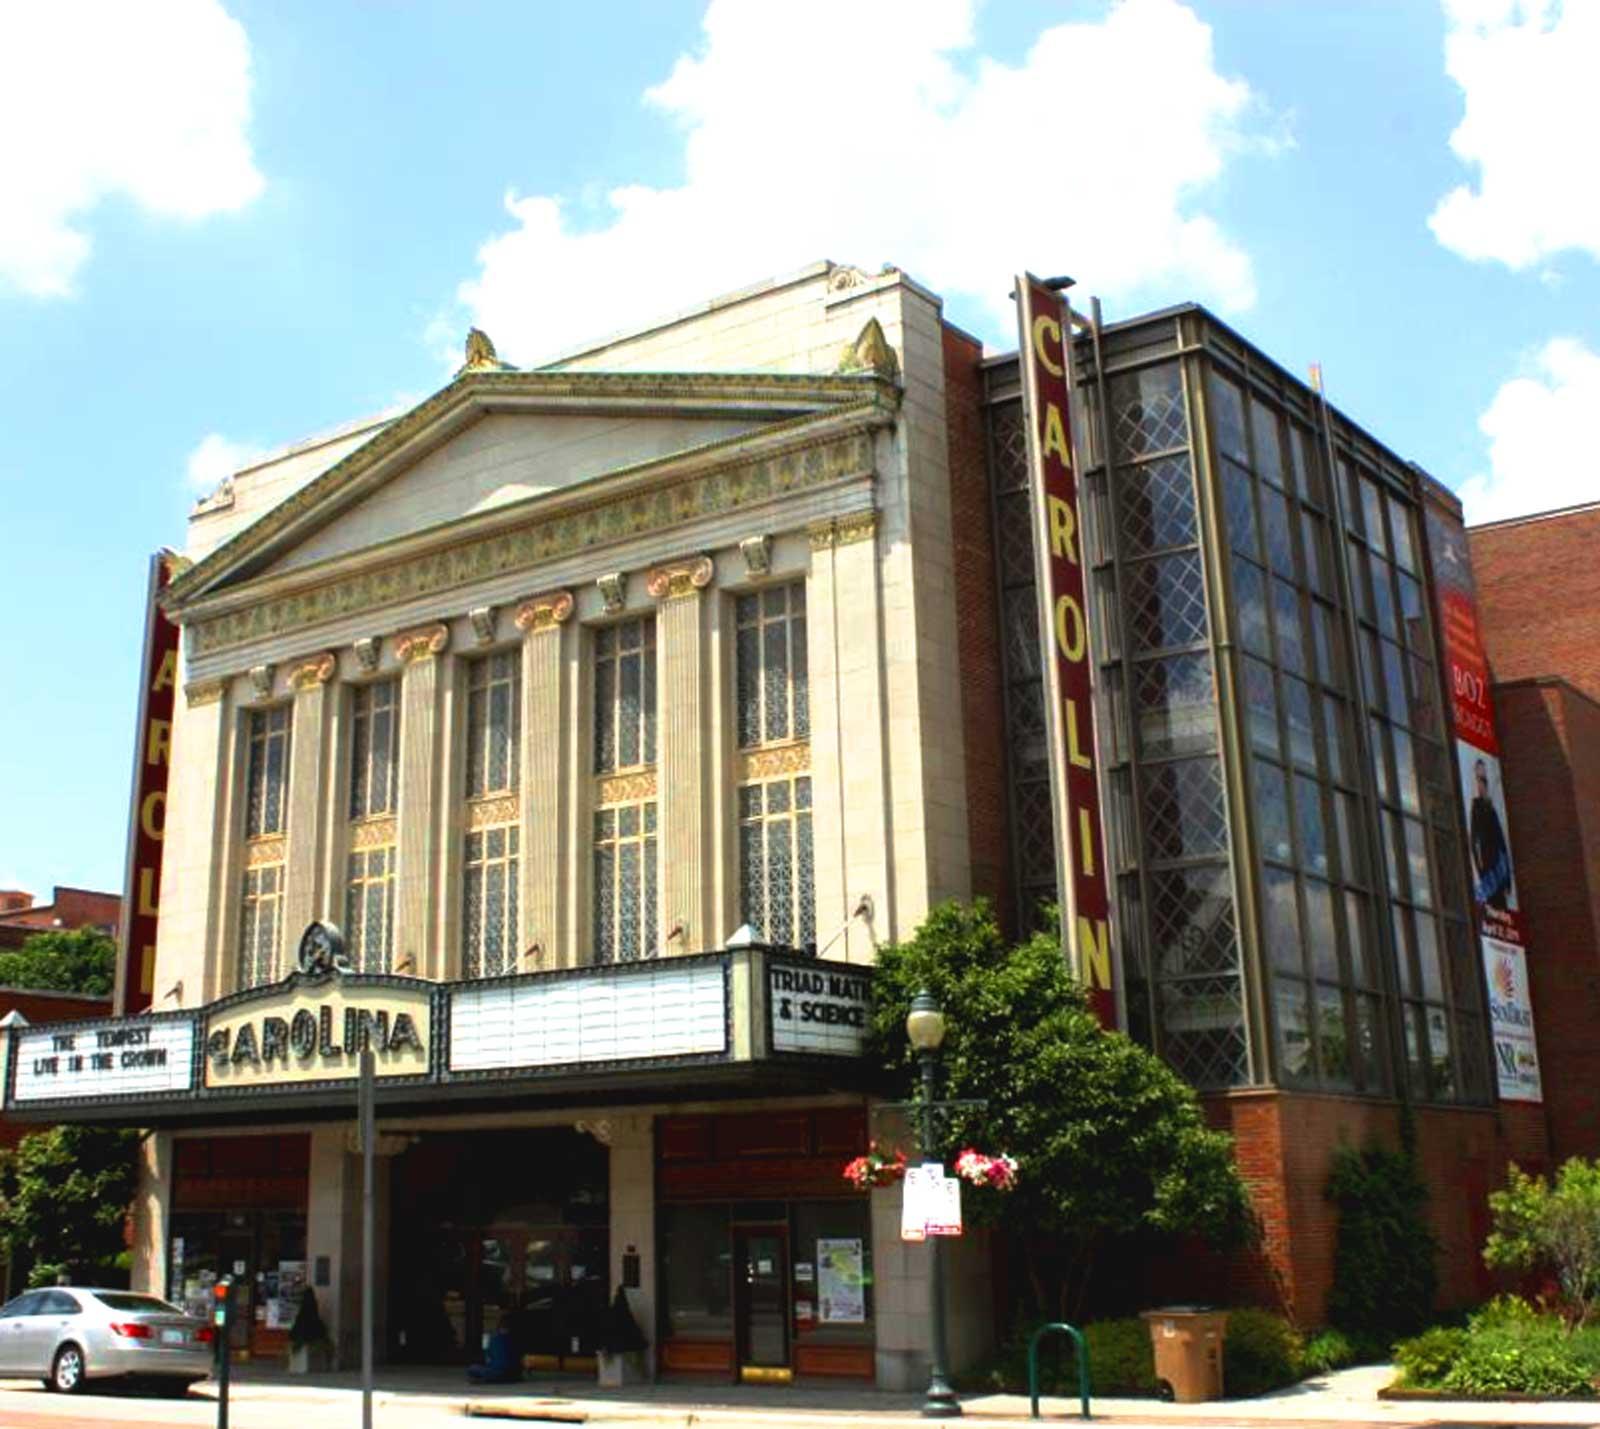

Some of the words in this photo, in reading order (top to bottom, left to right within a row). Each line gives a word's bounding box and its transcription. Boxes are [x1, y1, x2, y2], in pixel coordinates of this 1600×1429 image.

[771, 968, 825, 993] TRIAD
[779, 997, 793, 1021] &
[800, 1000, 866, 1029] SCIENCE
[52, 1033, 76, 1052] THE
[96, 1026, 152, 1048] TEMPEST
[207, 1004, 425, 1066] CAROLINA
[33, 1055, 60, 1077] LIVE
[91, 1051, 114, 1071] THE
[120, 1047, 168, 1069] CROWN
